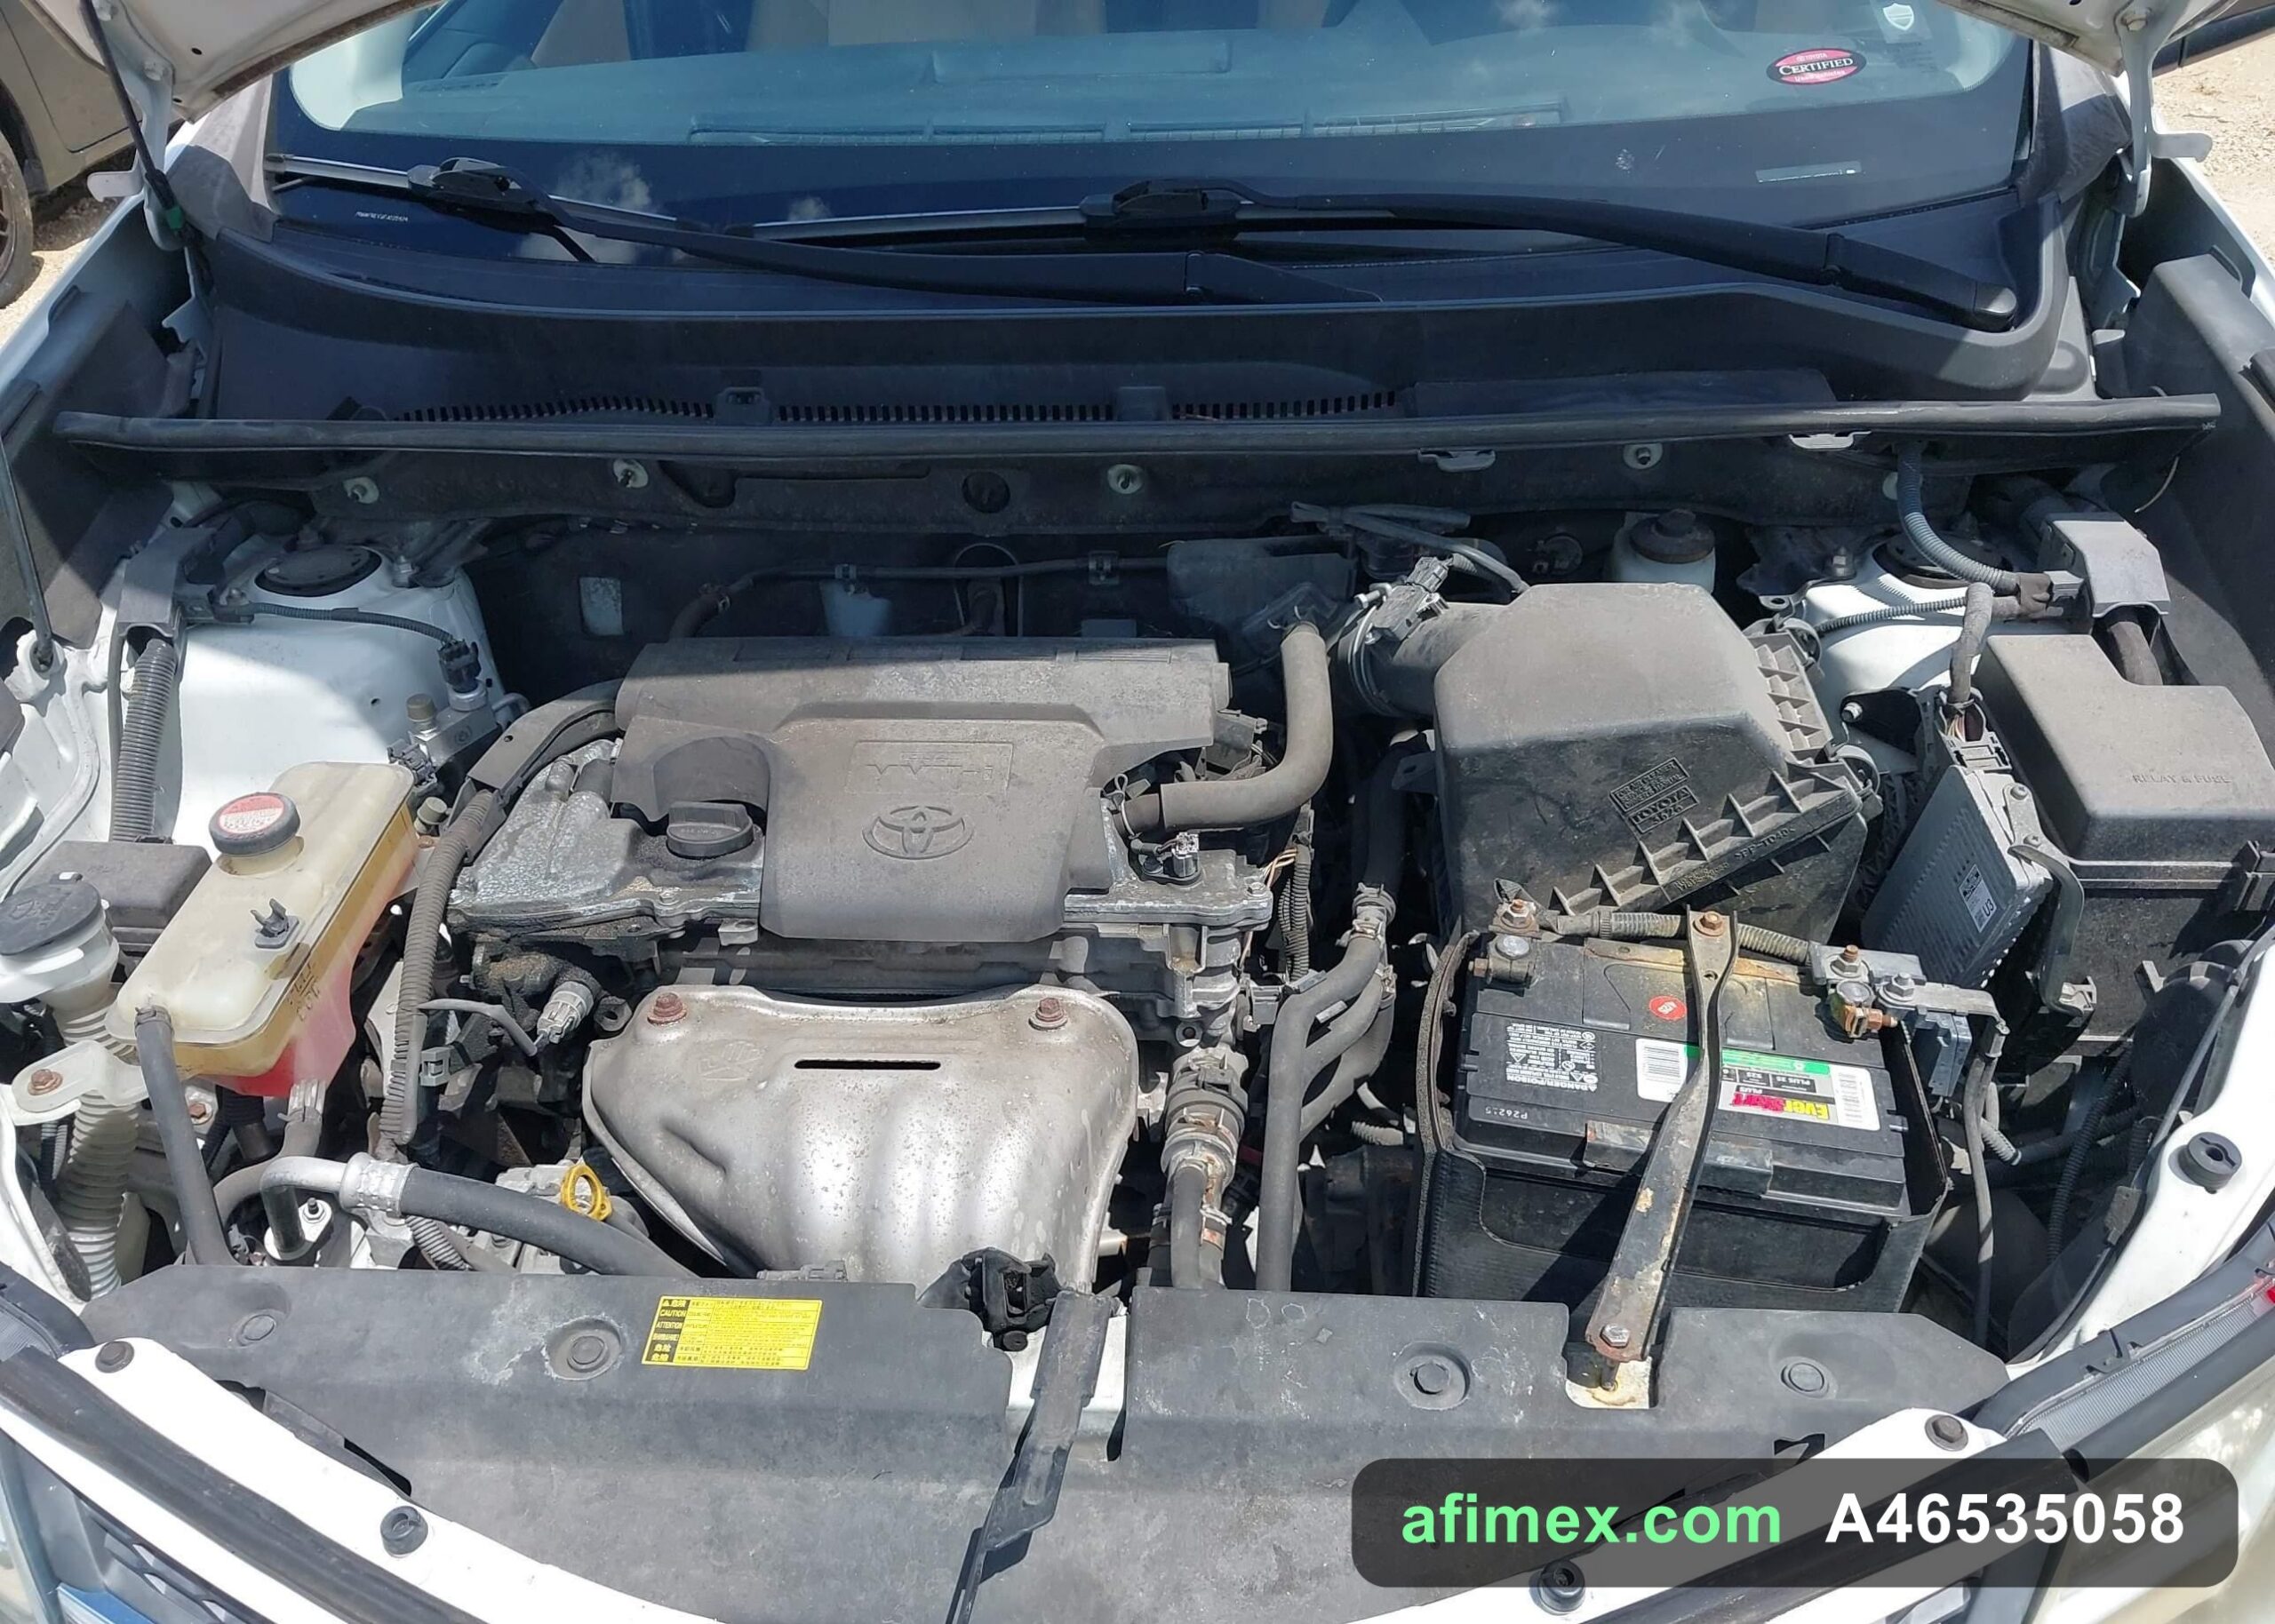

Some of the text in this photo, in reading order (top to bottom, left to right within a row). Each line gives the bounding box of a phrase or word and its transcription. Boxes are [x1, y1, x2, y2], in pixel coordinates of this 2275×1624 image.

[1778, 58, 1854, 76] CERTIFIED
[2132, 774, 2176, 783] RELAY
[1633, 787, 1689, 822] TOYOTA
[1981, 898, 1994, 917] U3
[1731, 1093, 1830, 1120] EverStart
[659, 1309, 687, 1318] CAUTION
